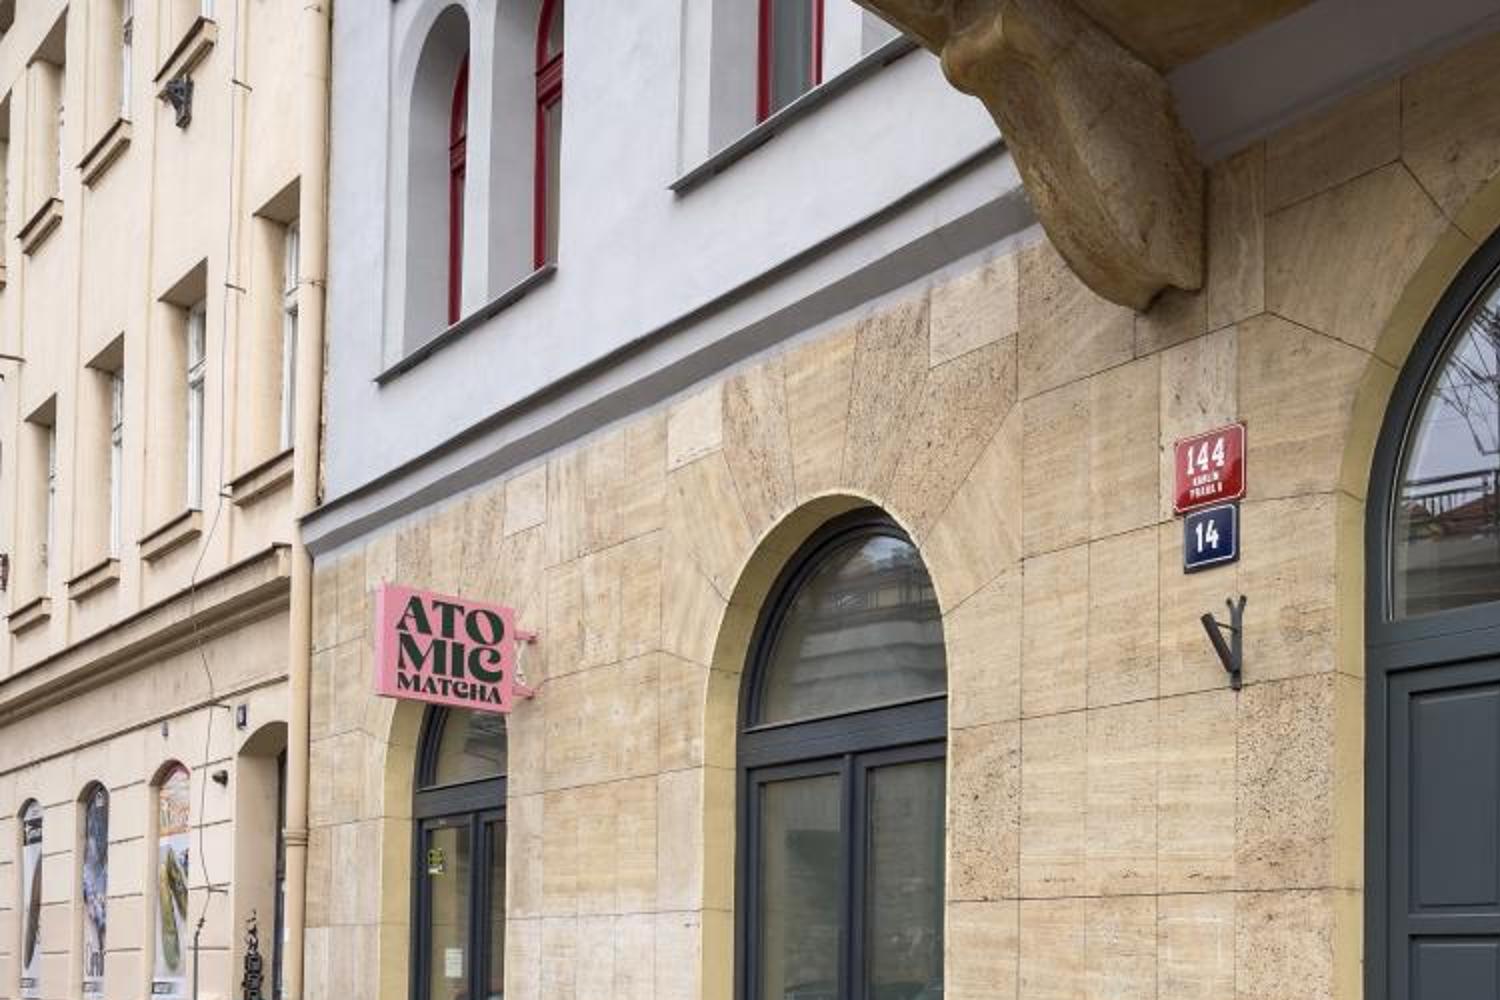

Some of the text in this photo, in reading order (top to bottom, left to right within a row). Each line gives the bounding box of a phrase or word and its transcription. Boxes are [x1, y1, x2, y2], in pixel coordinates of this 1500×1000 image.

[1187, 437, 1225, 475] 144
[1195, 519, 1219, 553] 14
[396, 595, 504, 646] ATO
[398, 633, 504, 684] MIC
[397, 671, 503, 705] MATCHA
